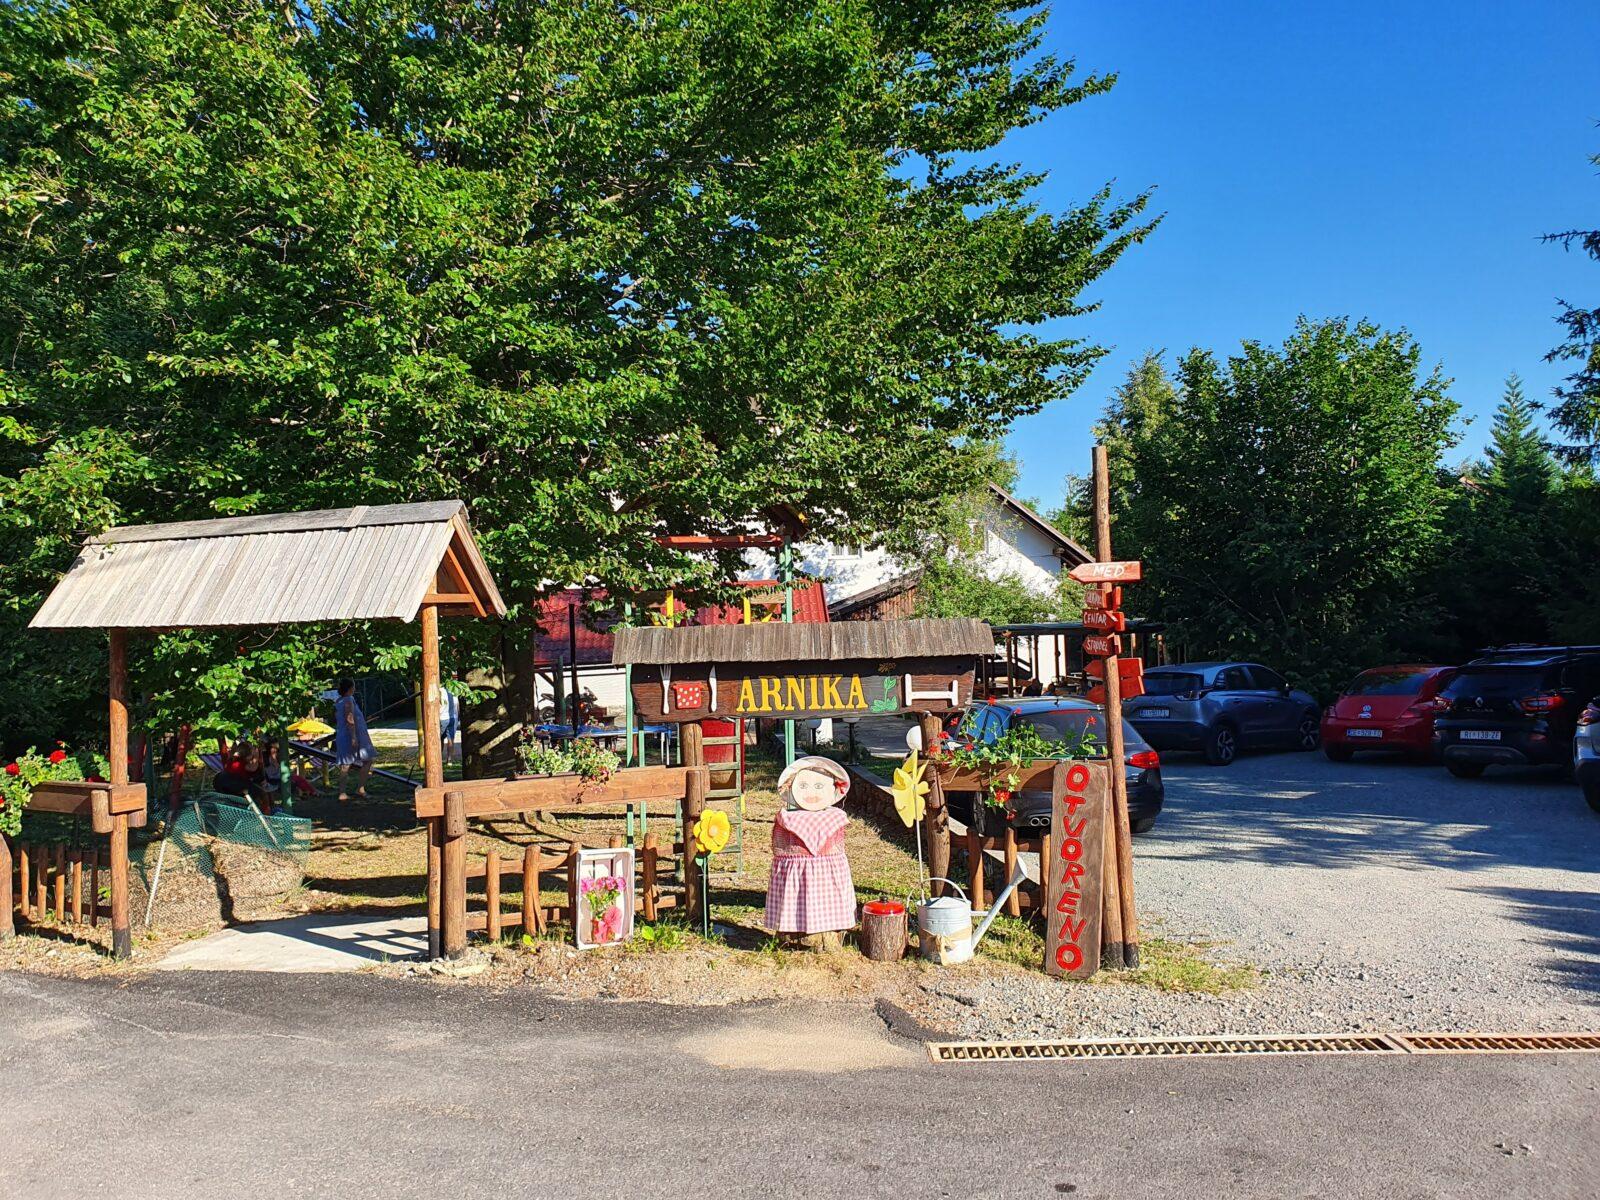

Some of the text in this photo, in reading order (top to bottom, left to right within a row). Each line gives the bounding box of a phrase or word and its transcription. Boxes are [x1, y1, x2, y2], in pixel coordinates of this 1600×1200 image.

[1093, 565, 1124, 577] MED
[1083, 611, 1107, 626] CENTAR
[736, 673, 868, 713] ARNIKA
[1055, 764, 1091, 972] OTVORENO
